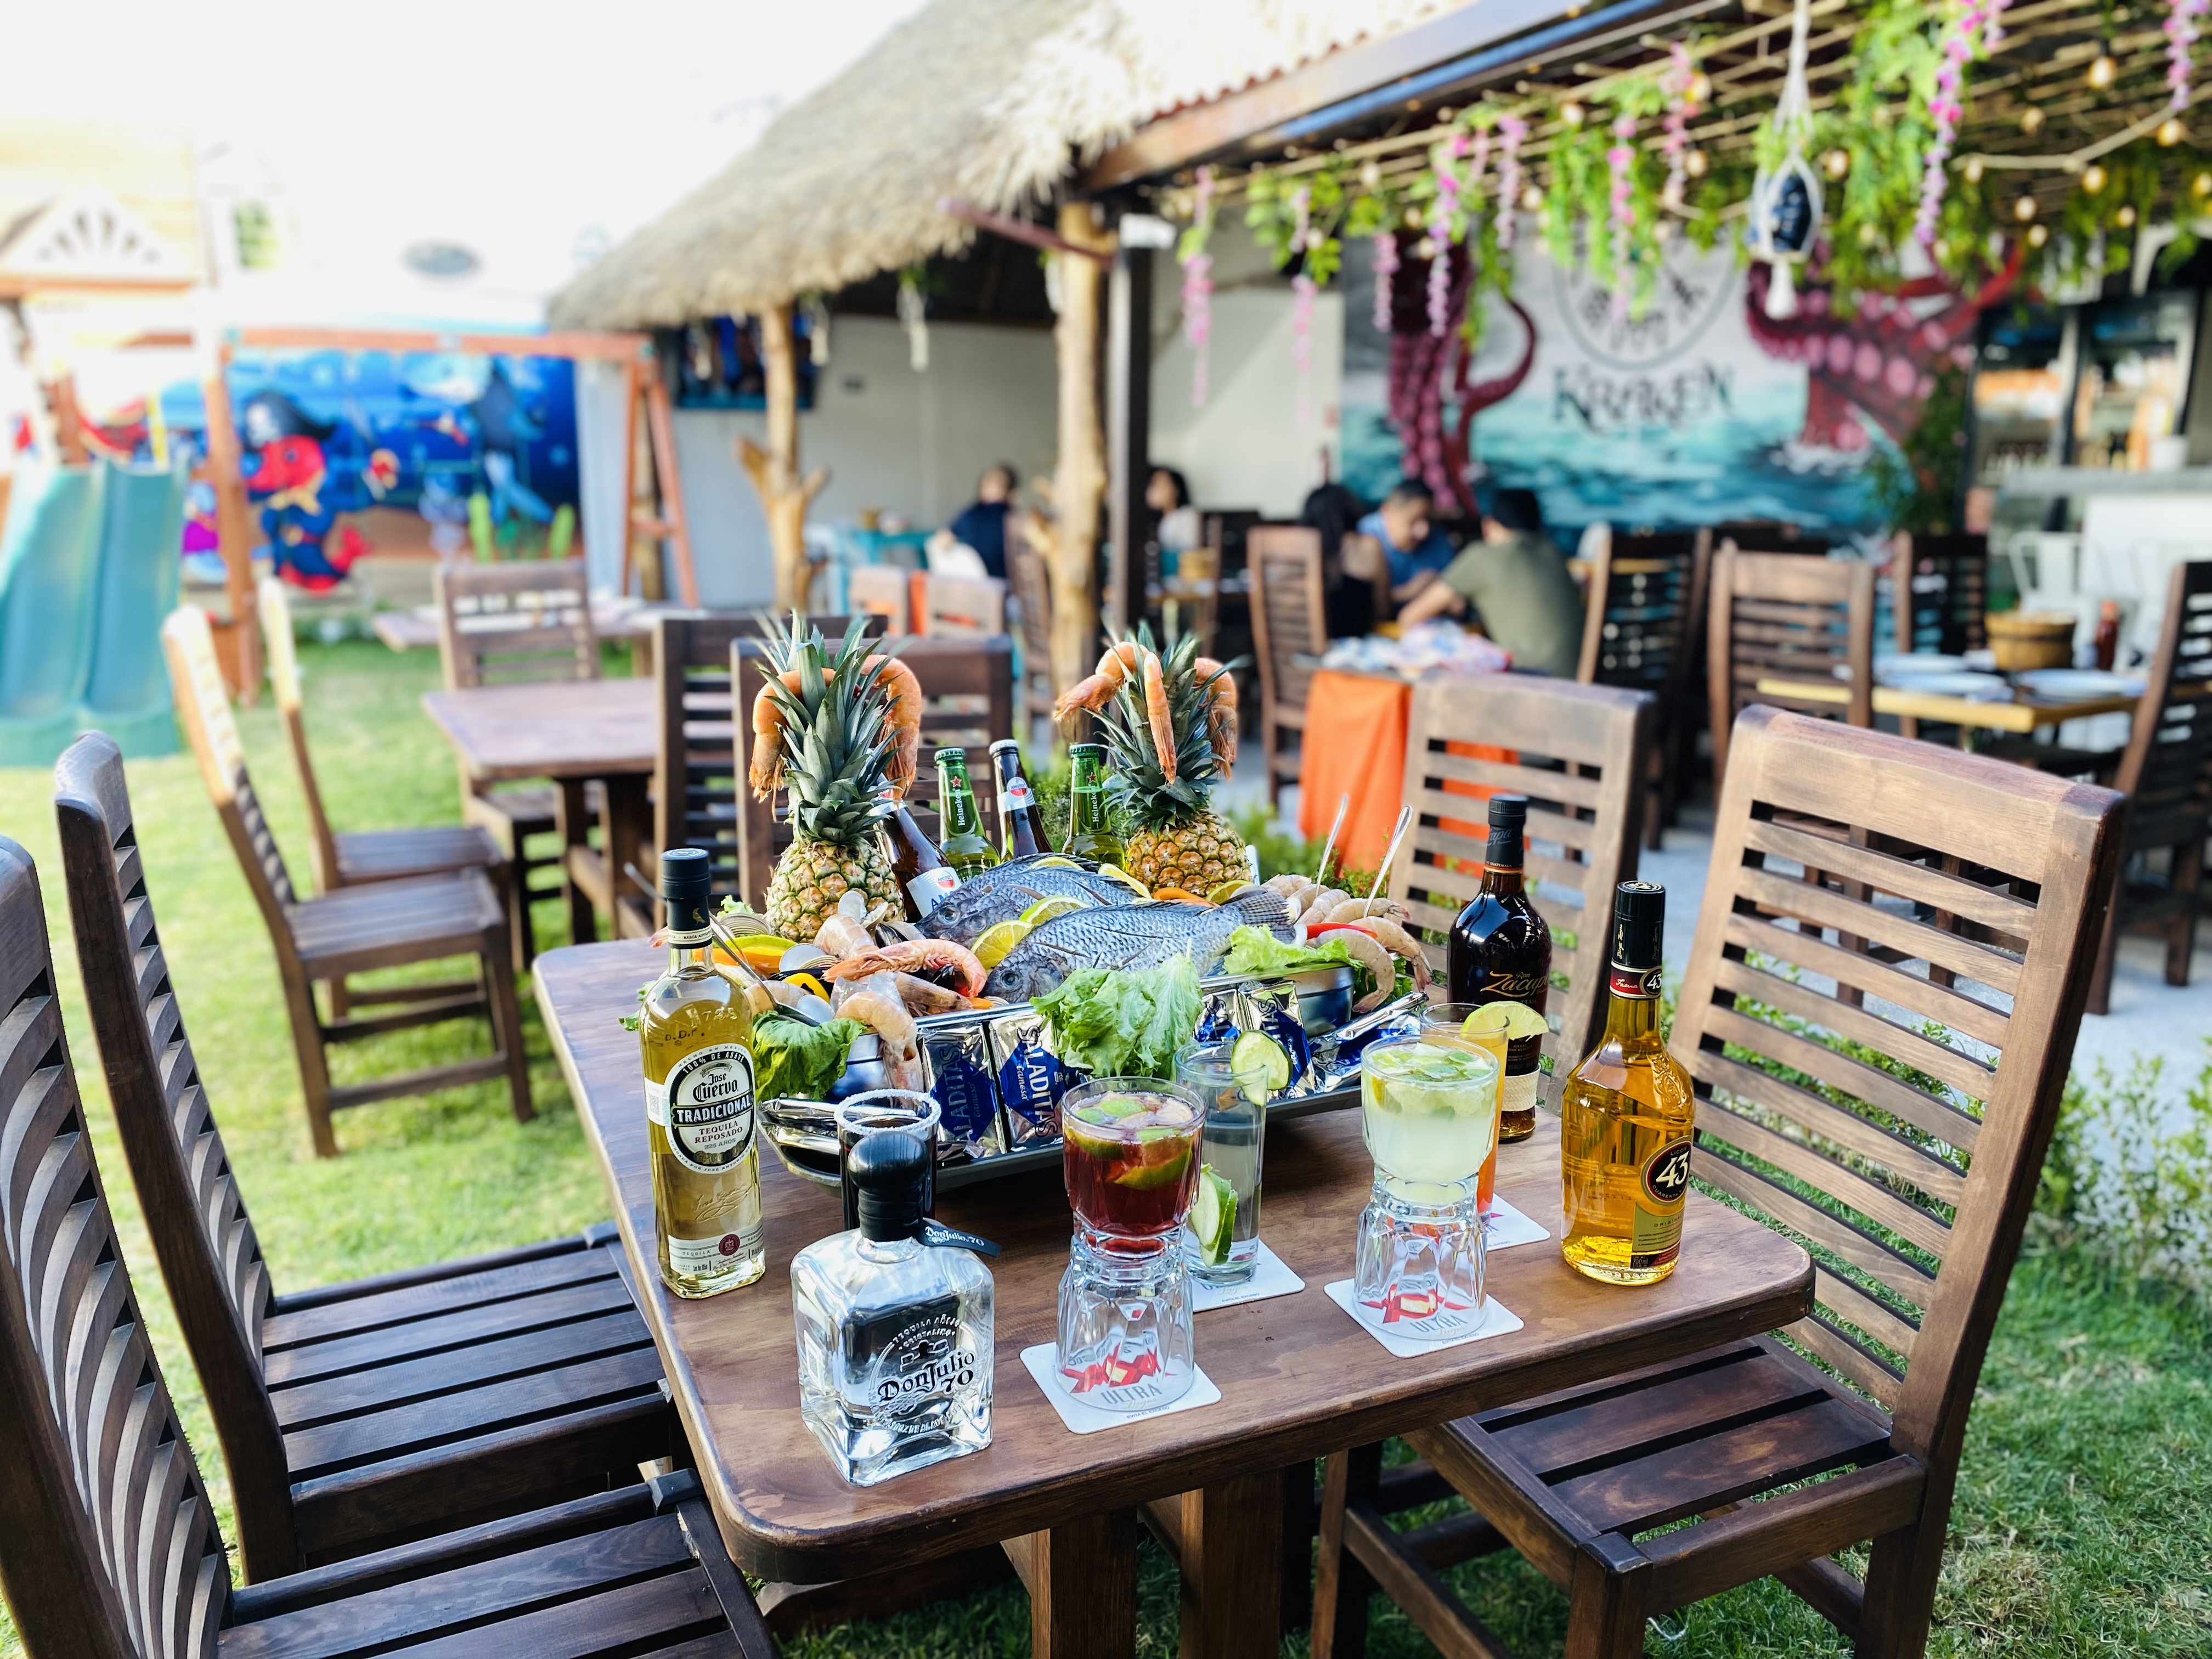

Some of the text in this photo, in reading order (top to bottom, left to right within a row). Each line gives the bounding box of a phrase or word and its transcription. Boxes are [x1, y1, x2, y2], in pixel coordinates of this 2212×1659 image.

[955, 788, 966, 826] Heineken
[1646, 973, 1662, 990] 43
[682, 1057, 707, 1074] 100%
[711, 1052, 721, 1060] DE
[725, 1051, 744, 1063] AGAVE
[708, 1073, 727, 1086] Jose
[692, 1079, 738, 1103] Cuervo
[939, 1045, 973, 1142] ALADITAS
[676, 1094, 751, 1123] TRADICIONAL
[695, 1126, 743, 1144] REPOSADO
[698, 1120, 738, 1135] TEQUILA
[718, 1138, 736, 1147] AÑOS
[1670, 1146, 1687, 1156] LICOR
[1656, 1150, 1690, 1188] 43
[1652, 1184, 1679, 1199] CUARENTA
[747, 1229, 763, 1242] REPO
[1409, 1314, 1469, 1333] ULTRA
[941, 1369, 974, 1393] 70
[1099, 1383, 1163, 1405] ULTRA
[1149, 1406, 1170, 1414] EXCESO
